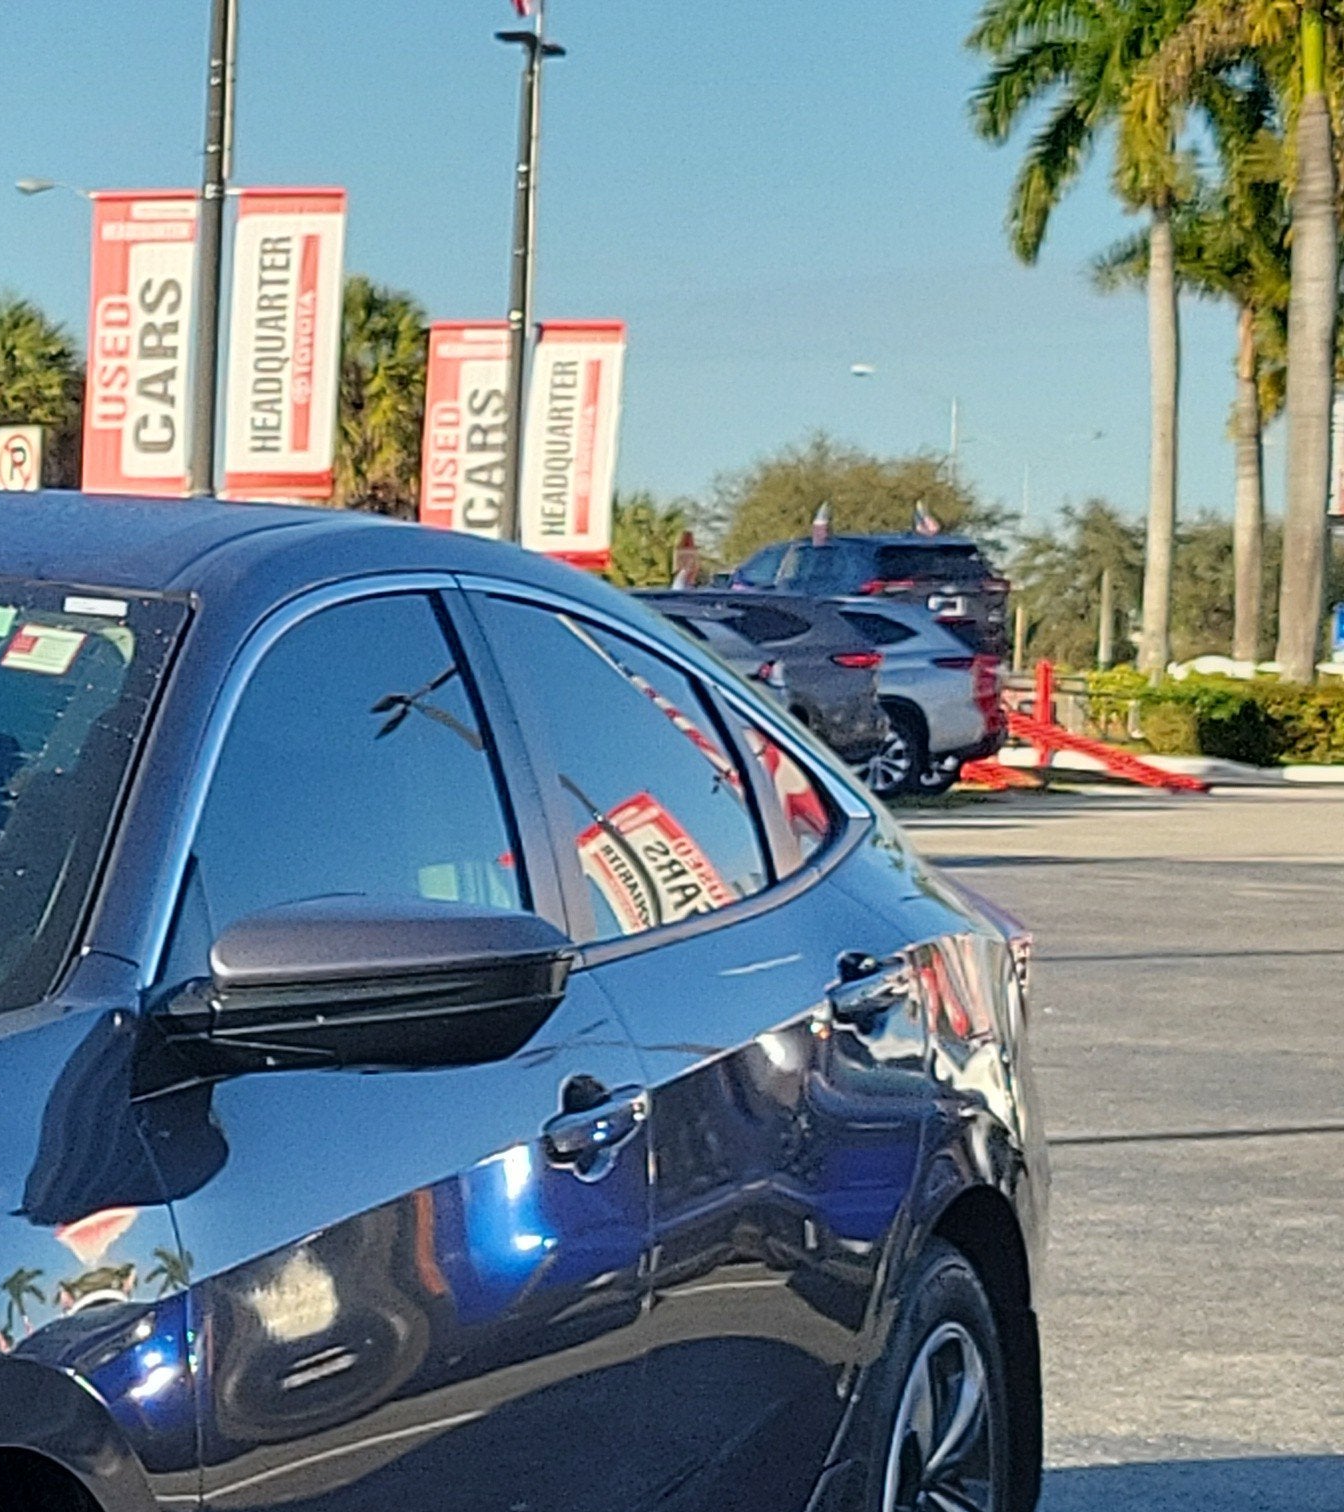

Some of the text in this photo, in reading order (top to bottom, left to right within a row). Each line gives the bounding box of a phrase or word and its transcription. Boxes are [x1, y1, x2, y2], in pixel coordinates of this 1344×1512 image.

[97, 301, 131, 422] USED
[133, 278, 182, 453] CARS
[249, 235, 293, 453] HEADQUARTER
[431, 406, 460, 502] USED
[463, 388, 507, 528] CARS
[541, 360, 579, 535] HEADQUARTER
